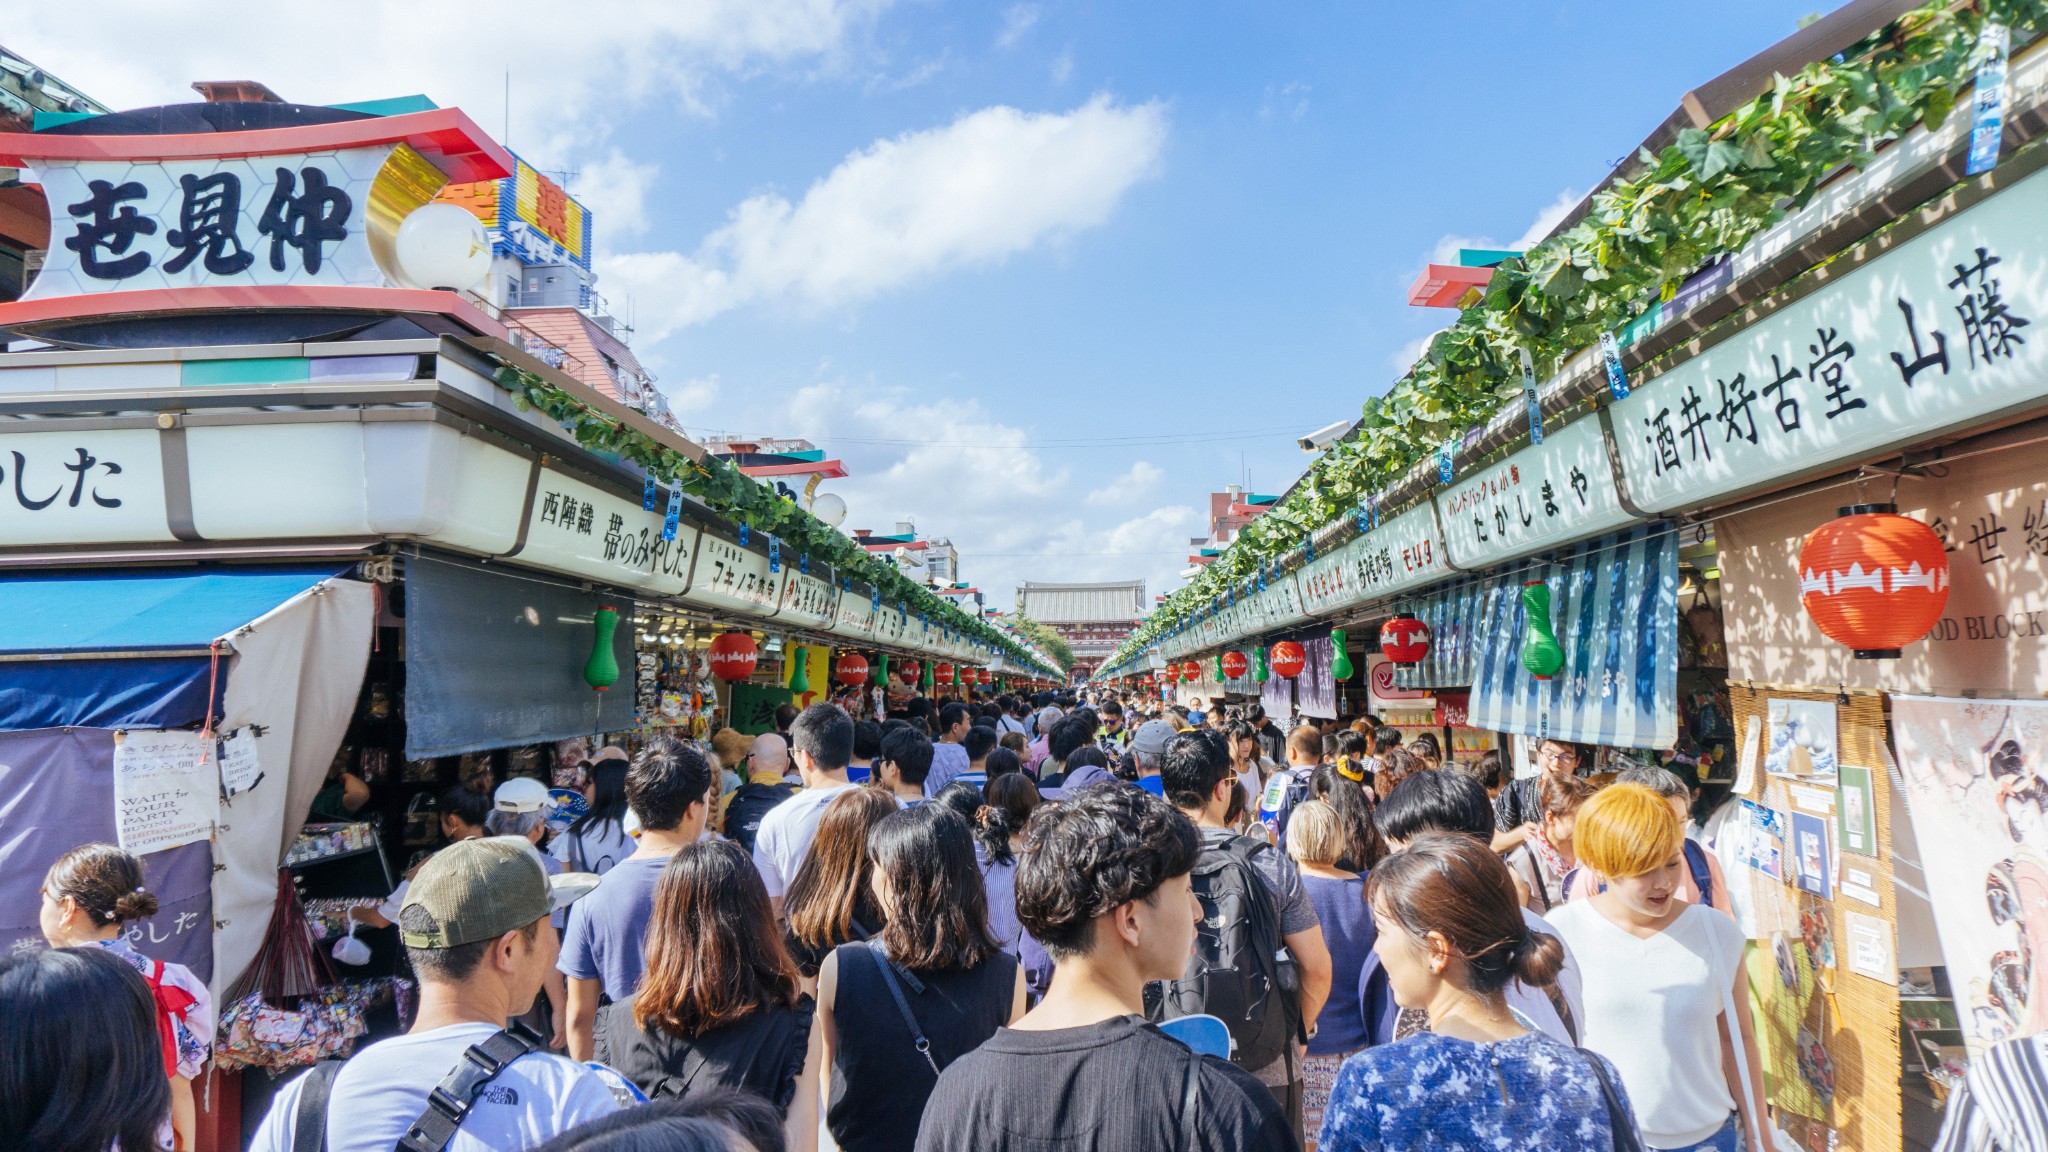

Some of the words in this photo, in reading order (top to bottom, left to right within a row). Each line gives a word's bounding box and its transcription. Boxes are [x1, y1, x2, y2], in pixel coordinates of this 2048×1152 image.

[537, 174, 568, 244] 薬
[1524, 364, 1542, 428] 仲見世
[1644, 327, 1867, 477] 酒井好古堂
[0, 447, 122, 511] した
[666, 490, 682, 531] 仲見世
[1474, 465, 1588, 544] たかしまや
[541, 491, 595, 536] 西陣織
[604, 513, 688, 578] 帯のみやした
[1402, 539, 1432, 573] モリタ
[1964, 611, 2045, 641] BLOCK
[121, 792, 169, 806] WAIT
[121, 800, 176, 816] YOUR
[123, 808, 183, 826] PARTY
[123, 819, 172, 833] BUYING
